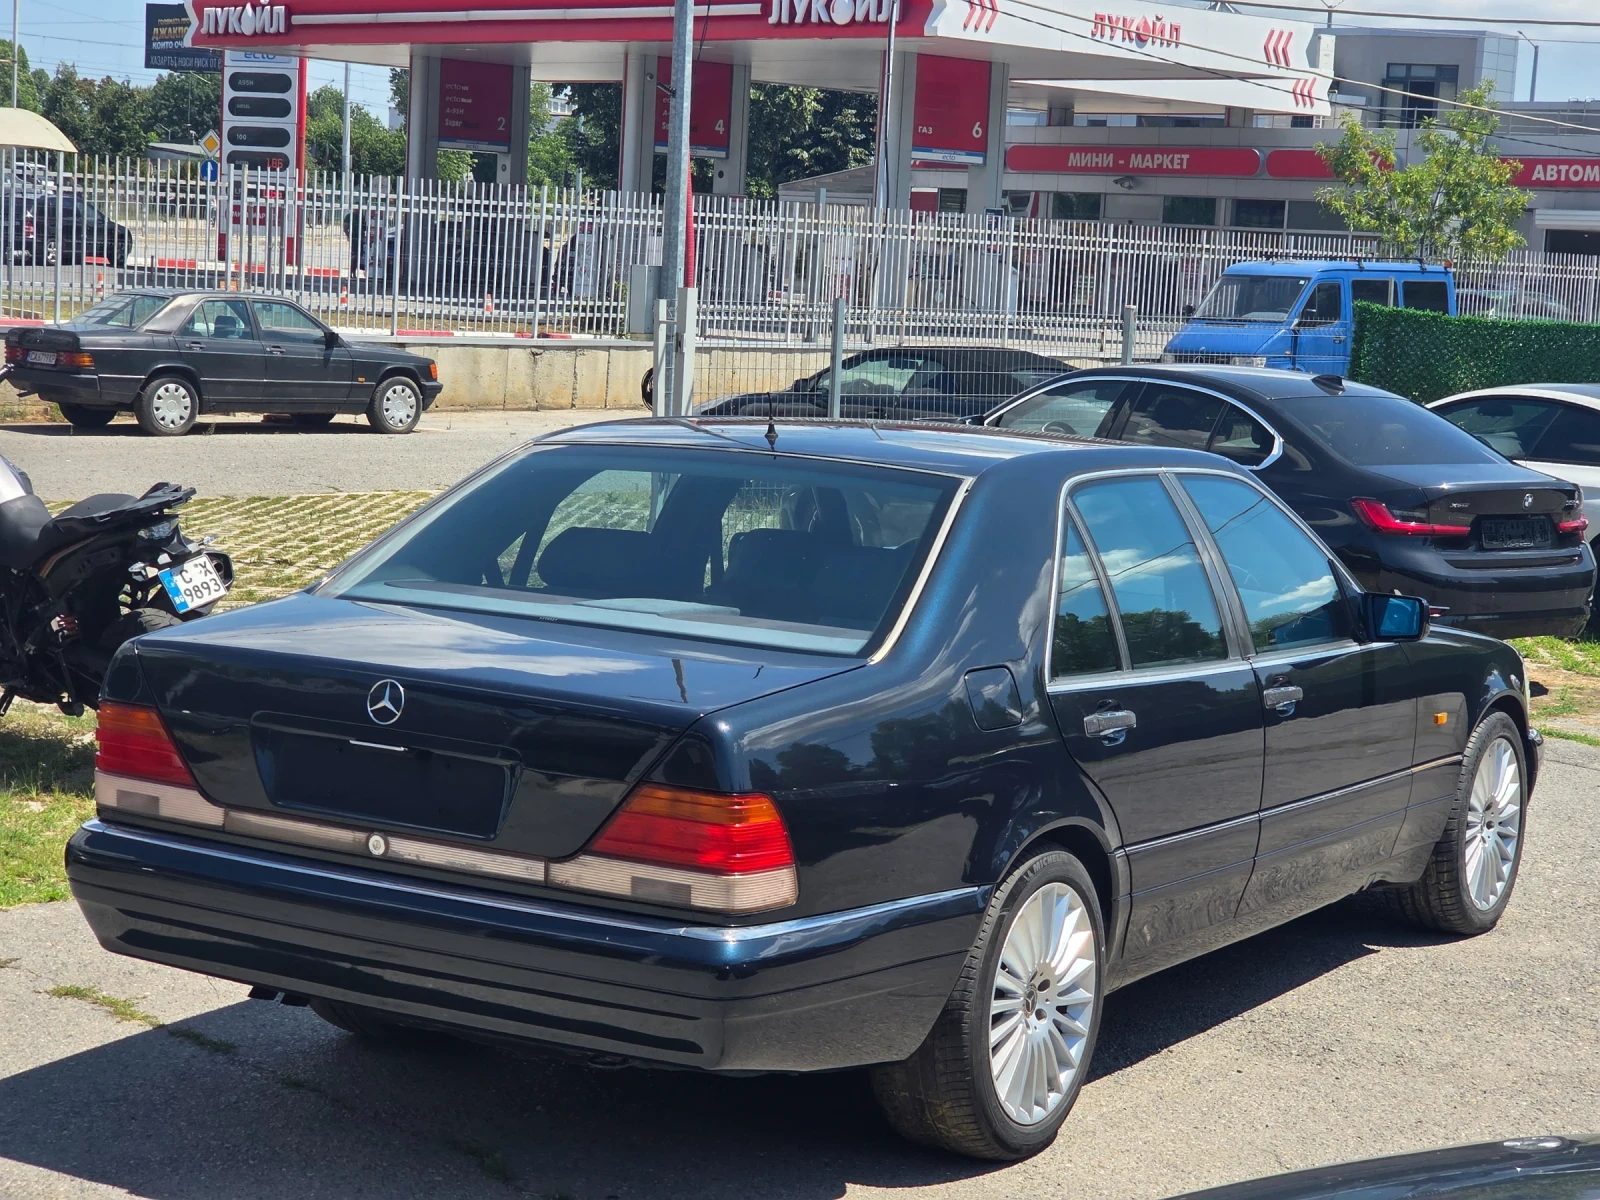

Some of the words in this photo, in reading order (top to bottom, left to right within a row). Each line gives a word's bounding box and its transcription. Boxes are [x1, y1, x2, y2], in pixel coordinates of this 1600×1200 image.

[497, 116, 506, 131] 2
[714, 119, 725, 135] 4
[918, 126, 933, 134] ГАЗ
[972, 121, 983, 138] 6
[236, 133, 247, 141] 100
[1068, 152, 1113, 168] МИНИ
[1129, 153, 1190, 169] МАРКЕТ
[180, 569, 193, 584] C
[183, 578, 221, 603] 9893
